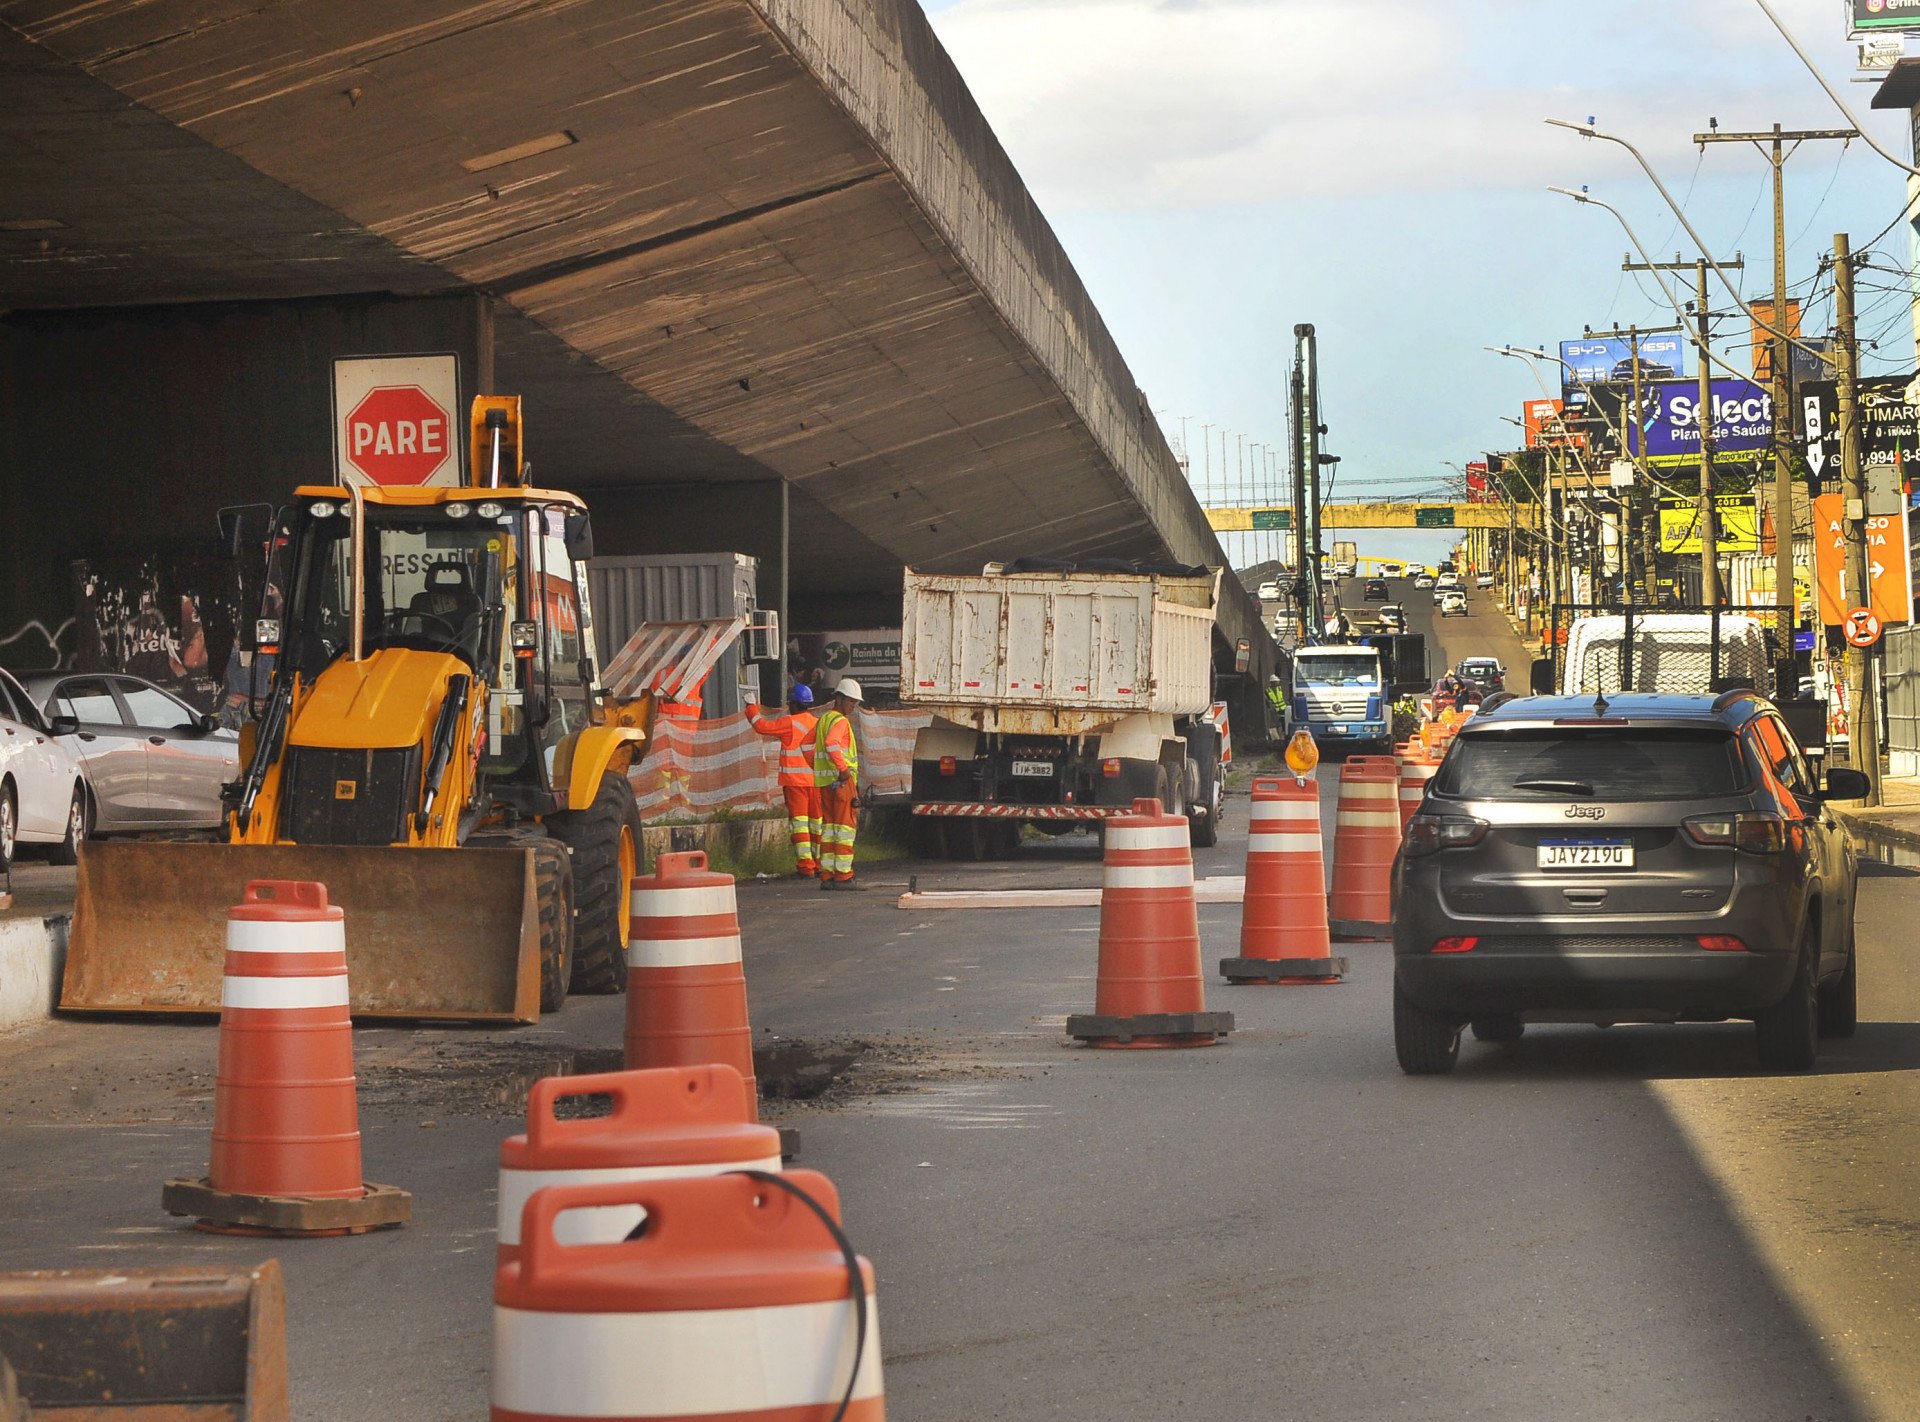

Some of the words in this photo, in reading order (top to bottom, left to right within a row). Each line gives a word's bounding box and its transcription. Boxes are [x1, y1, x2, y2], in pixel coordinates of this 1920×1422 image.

[1567, 345, 1607, 356] BYD
[354, 418, 442, 456] PARE
[1671, 428, 1700, 441] Plan
[1732, 423, 1772, 437] Saúde
[1829, 517, 1889, 533] ASO
[852, 647, 883, 659] Rainha
[884, 646, 896, 657] da
[1564, 804, 1606, 821] Jeep
